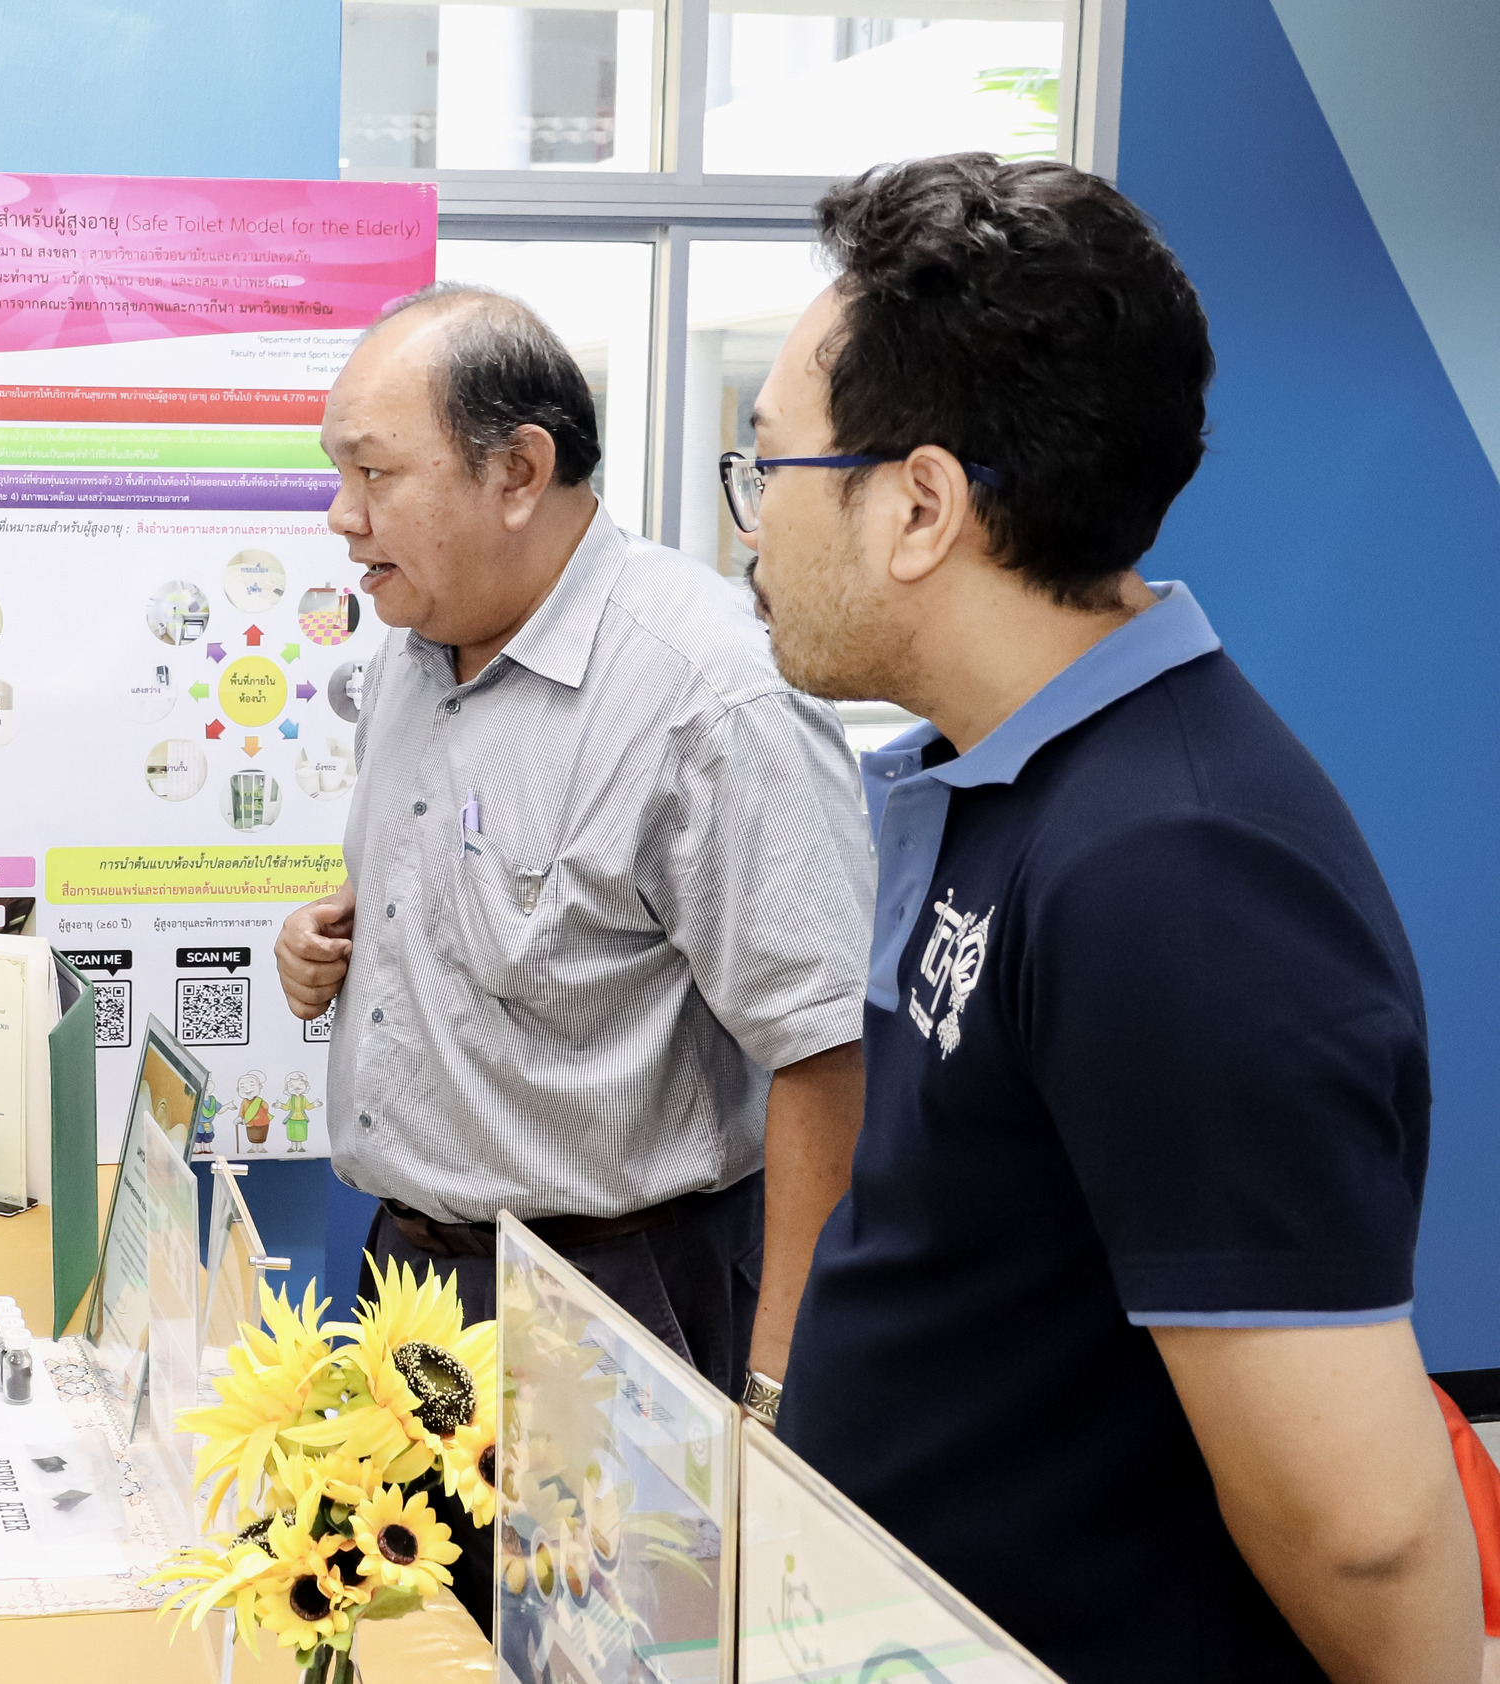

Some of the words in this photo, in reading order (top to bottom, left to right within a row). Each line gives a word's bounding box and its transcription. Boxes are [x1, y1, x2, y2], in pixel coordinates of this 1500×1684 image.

[125, 214, 168, 233] (Safe
[175, 215, 224, 234] Toilet
[231, 215, 285, 234] Model
[292, 216, 315, 234] for
[322, 217, 349, 235] the
[356, 218, 422, 240] Elderly)
[38, 245, 77, 259] สงขลา
[210, 391, 221, 401] 60
[229, 672, 276, 686] พื้นที่ภายใน
[238, 690, 267, 704] ห้องน้ำ
[58, 919, 93, 932] ผู้สูงอายุ
[153, 916, 273, 932] ผู้สูงอายุและพิการทางสายตา
[67, 954, 100, 966] SCAN
[104, 954, 122, 965] ME
[186, 951, 219, 963] SCAN
[223, 951, 241, 963] ME
